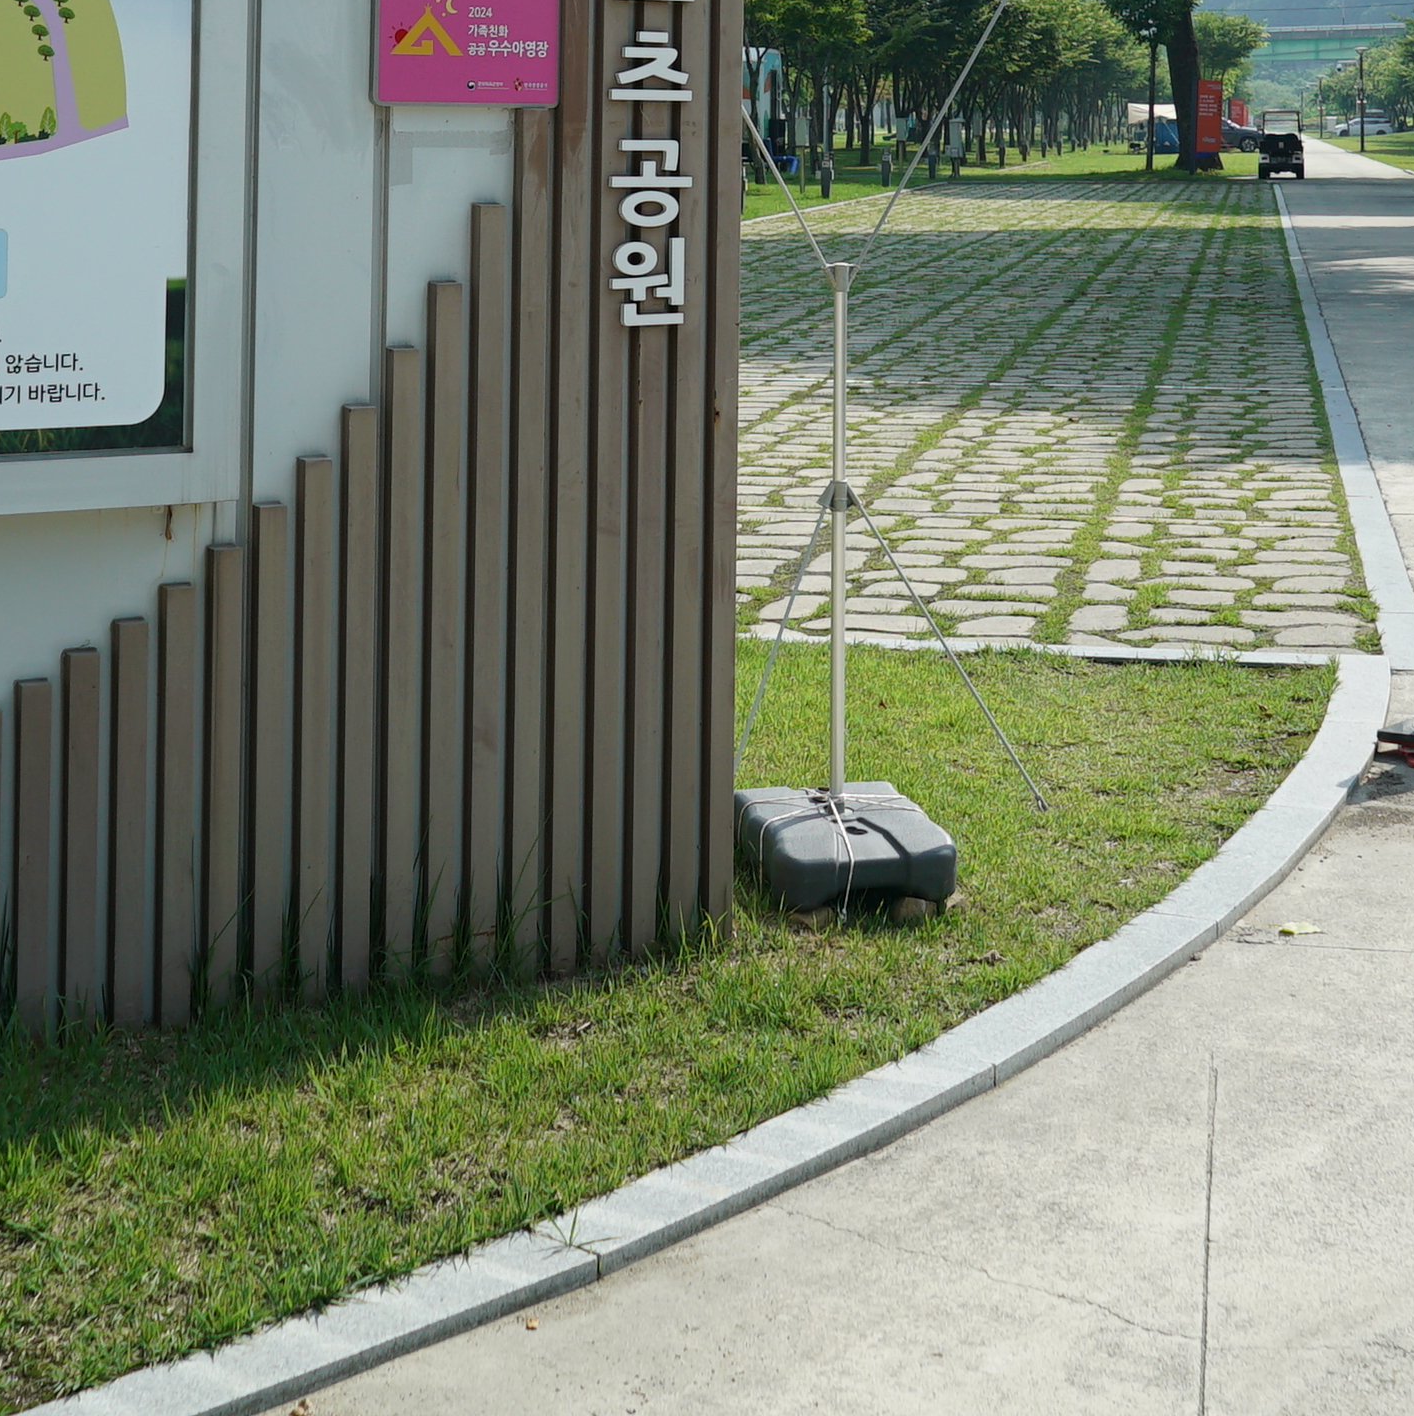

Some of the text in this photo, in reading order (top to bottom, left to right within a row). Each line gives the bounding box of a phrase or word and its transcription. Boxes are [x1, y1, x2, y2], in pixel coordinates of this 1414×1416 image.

[468, 6, 493, 18] 2024
[467, 24, 509, 38] 가족친화
[467, 40, 549, 59] 공공 우수야영장
[5, 352, 84, 375] 않습니다.
[28, 382, 106, 404] 바랍니다.
